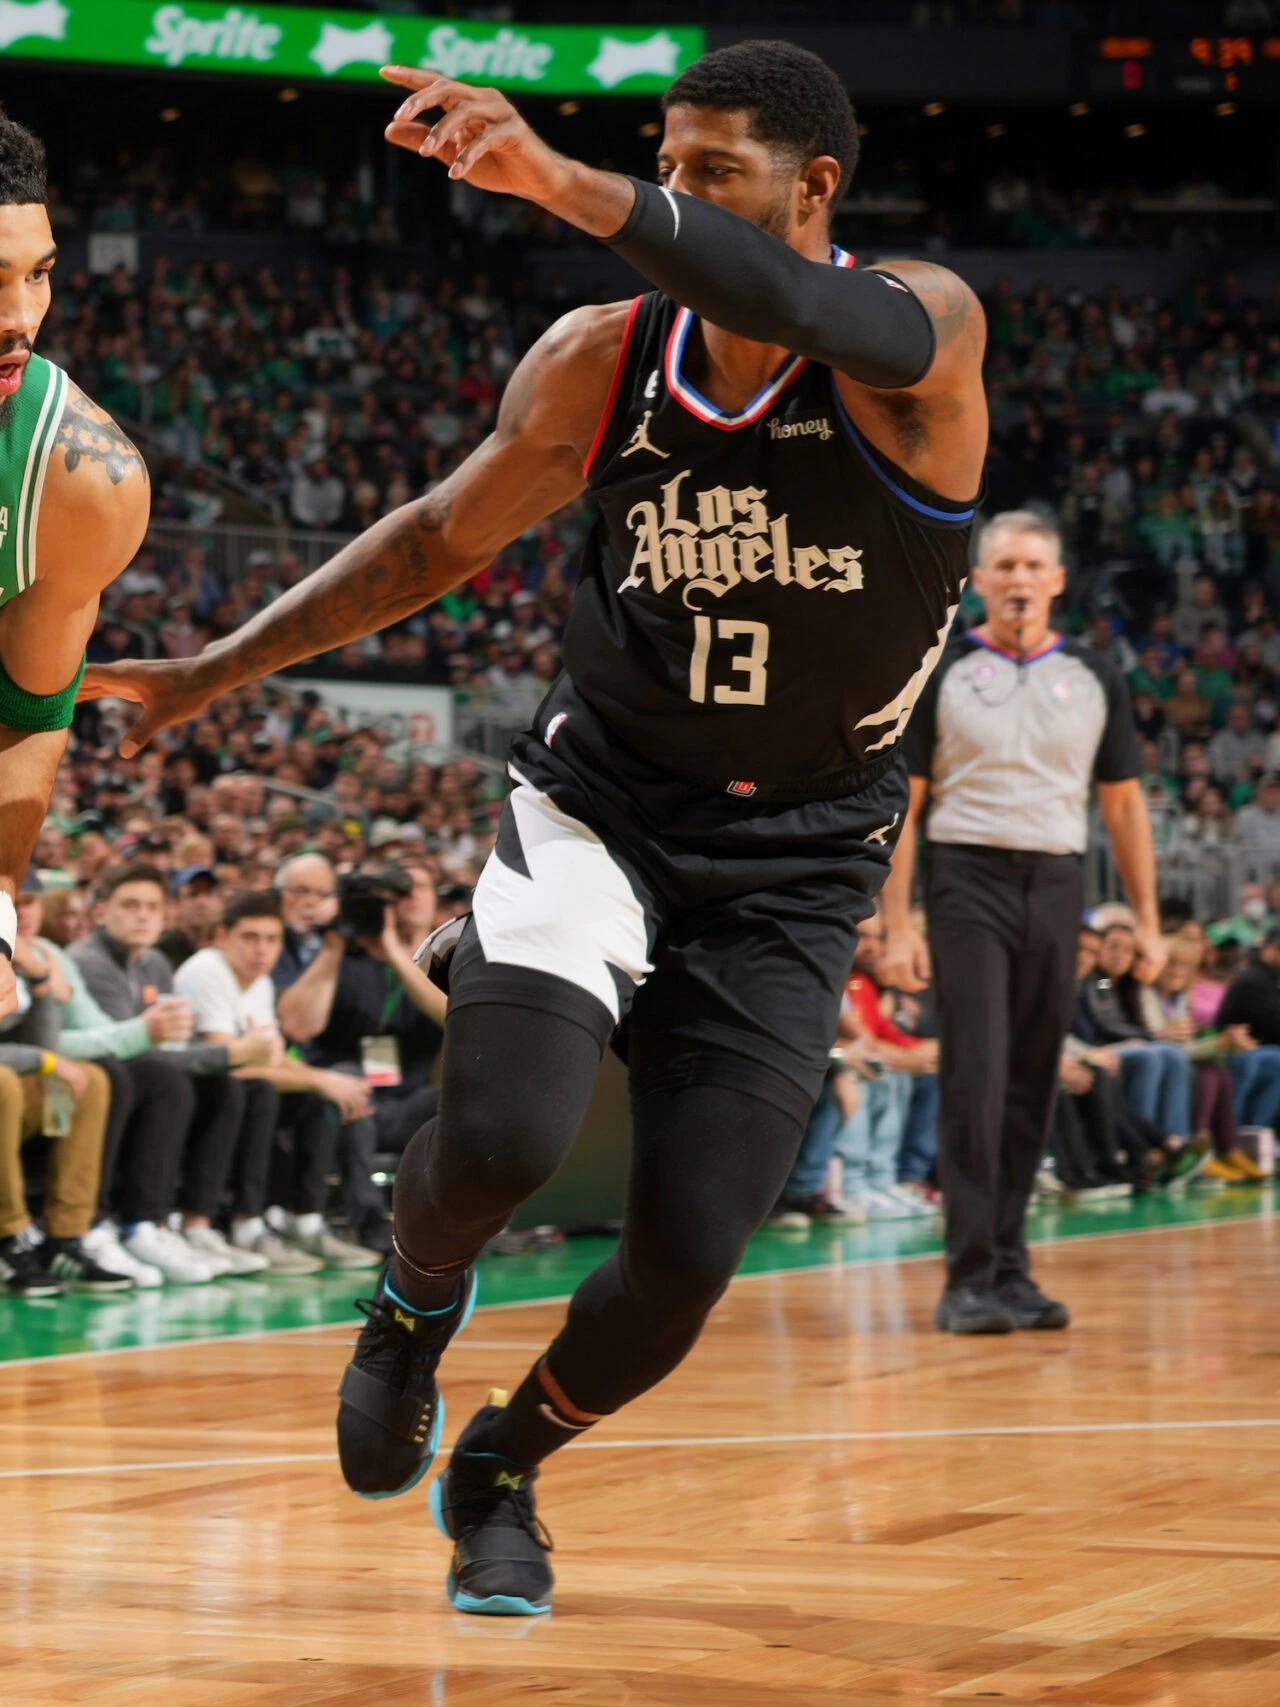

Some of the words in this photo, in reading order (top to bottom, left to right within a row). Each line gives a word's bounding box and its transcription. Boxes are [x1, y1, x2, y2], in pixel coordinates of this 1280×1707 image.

[145, 5, 282, 66] Sprite
[422, 25, 552, 80] Sprite
[768, 416, 835, 441] honey
[660, 469, 770, 537] Los
[617, 500, 865, 612] Angeles
[688, 615, 770, 706] 13
